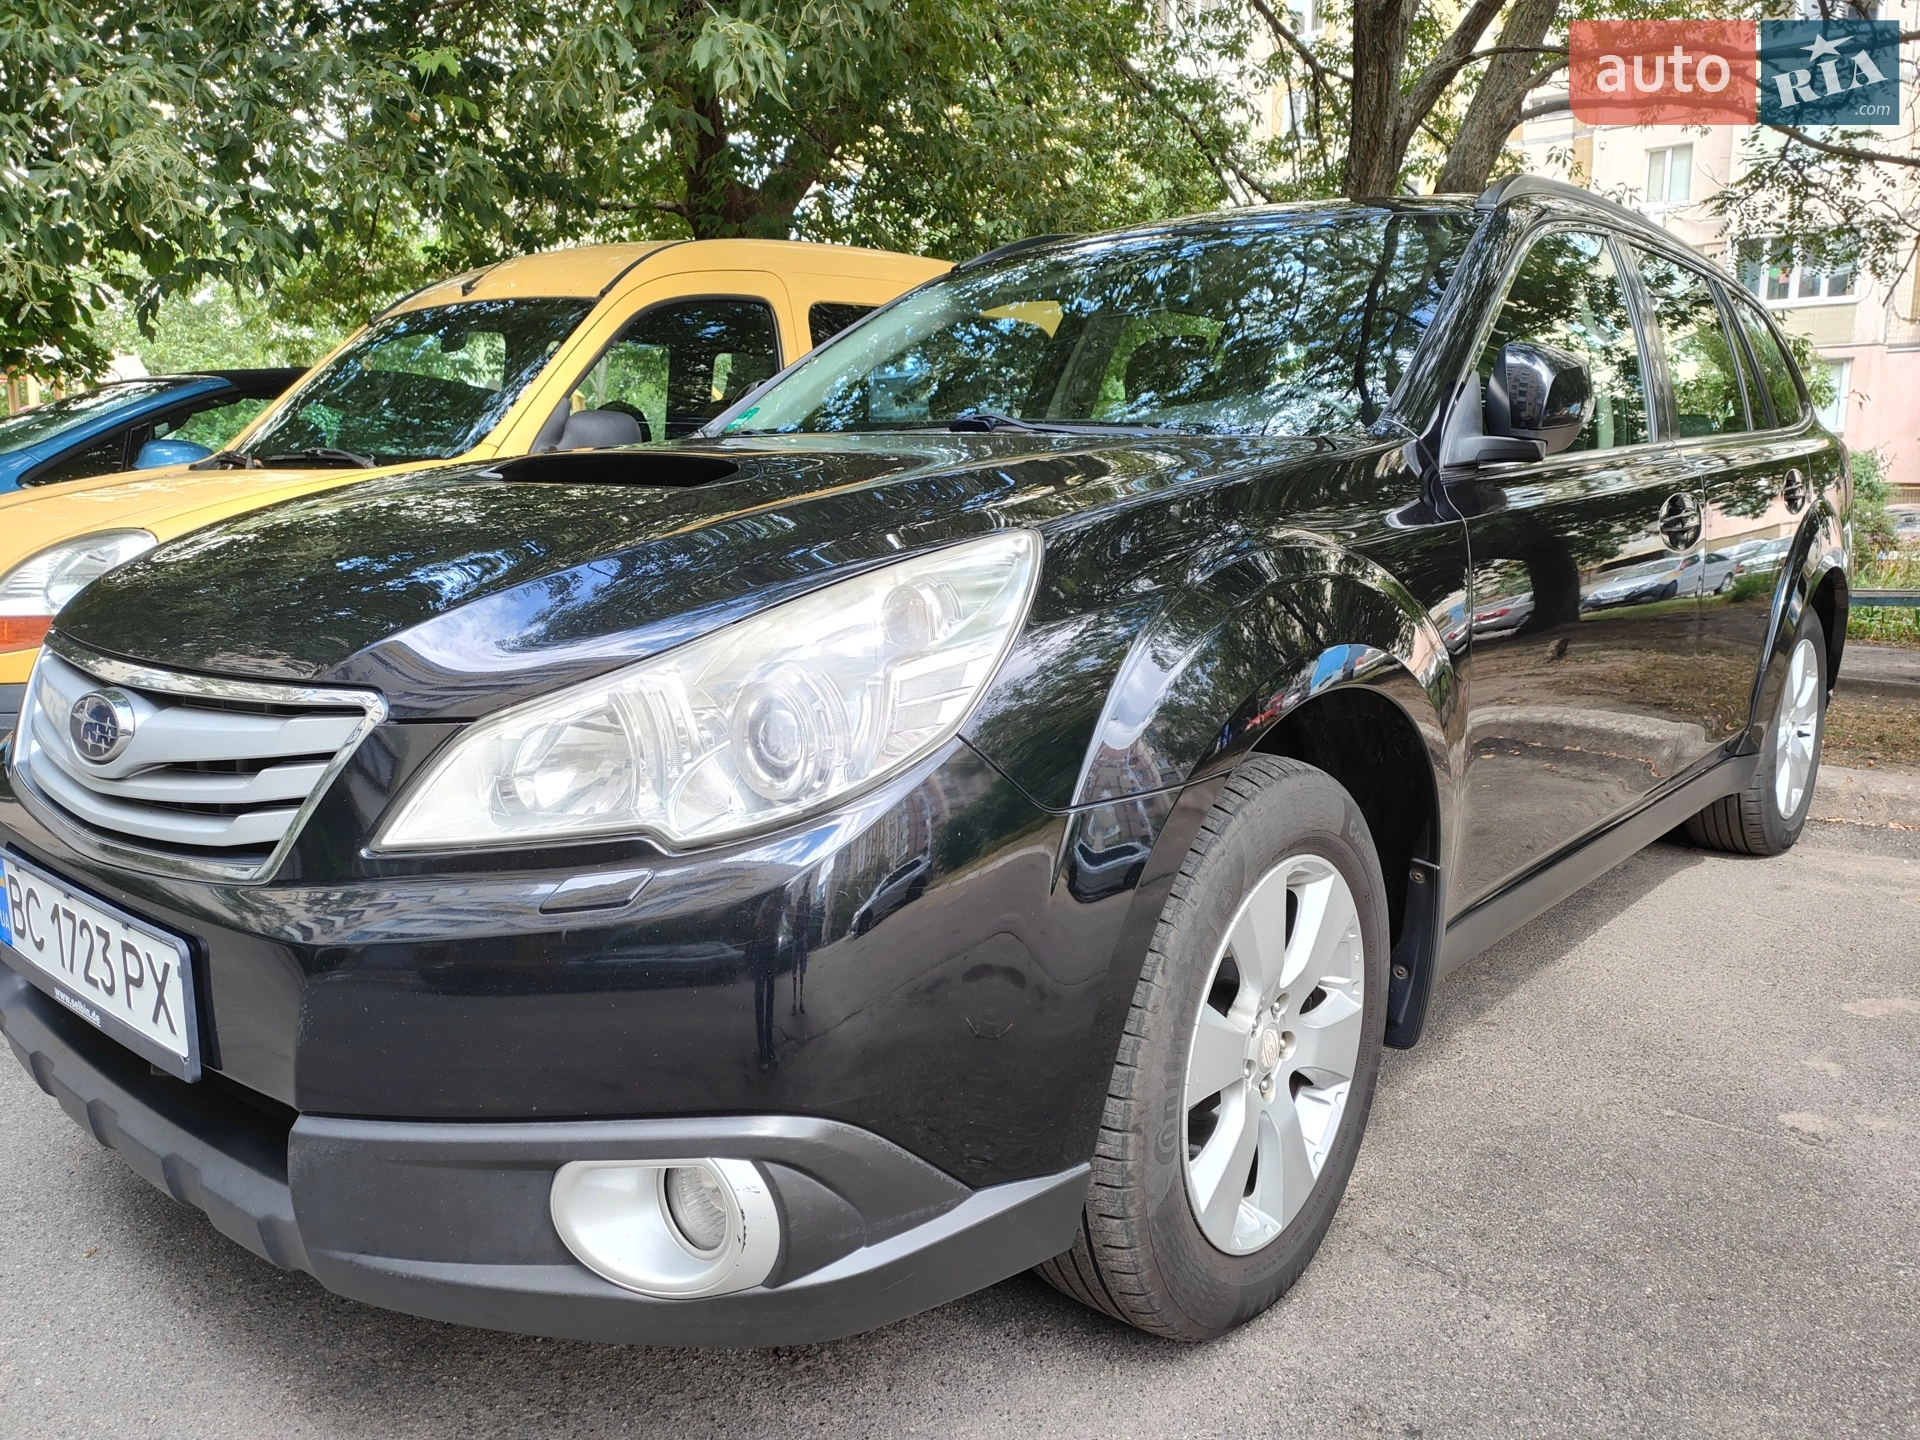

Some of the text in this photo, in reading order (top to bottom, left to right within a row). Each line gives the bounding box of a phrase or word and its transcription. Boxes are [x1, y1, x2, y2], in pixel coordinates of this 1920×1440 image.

[0, 908, 11, 932] UA
[7, 872, 178, 1036] BC 1723 PX
